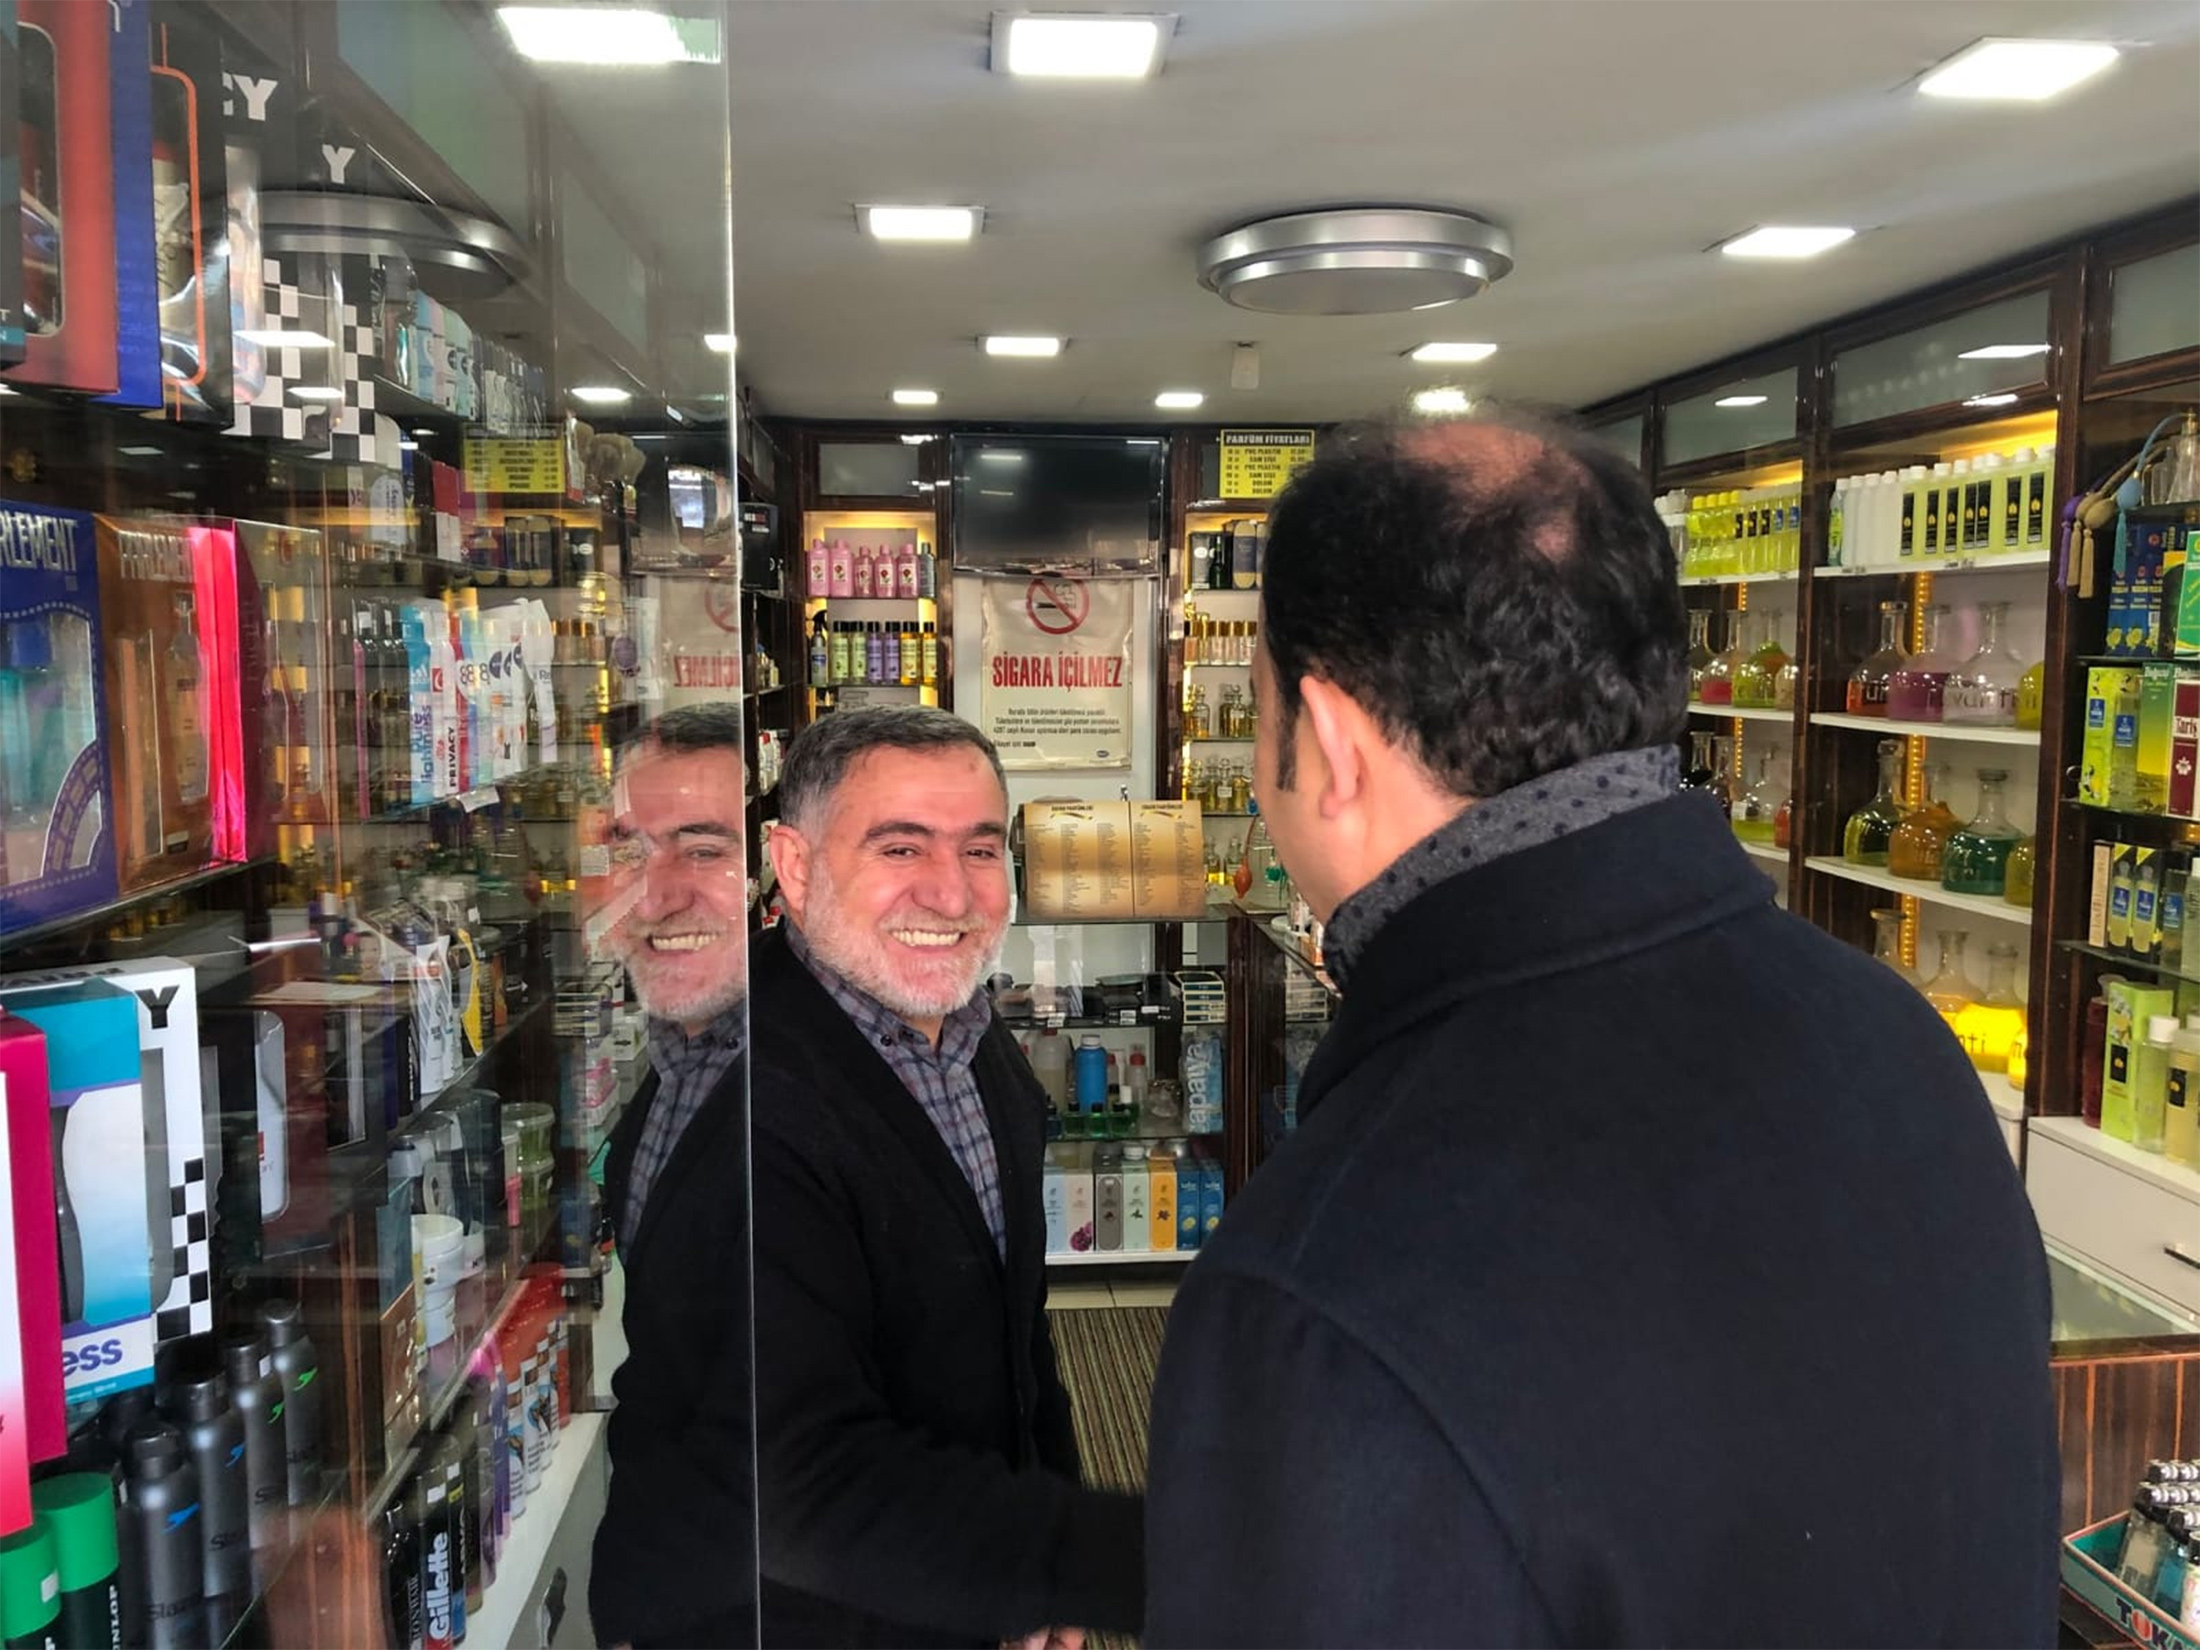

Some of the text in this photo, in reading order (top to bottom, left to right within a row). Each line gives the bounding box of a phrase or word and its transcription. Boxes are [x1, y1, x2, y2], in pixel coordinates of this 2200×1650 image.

[992, 651, 1123, 692] SİGARA İÇİLMEZ
[449, 726, 457, 788] PRIVACY
[134, 985, 180, 1030] Y
[63, 1338, 124, 1378] ess
[426, 1531, 450, 1640] Gillette
[109, 1584, 122, 1650] NLOP
